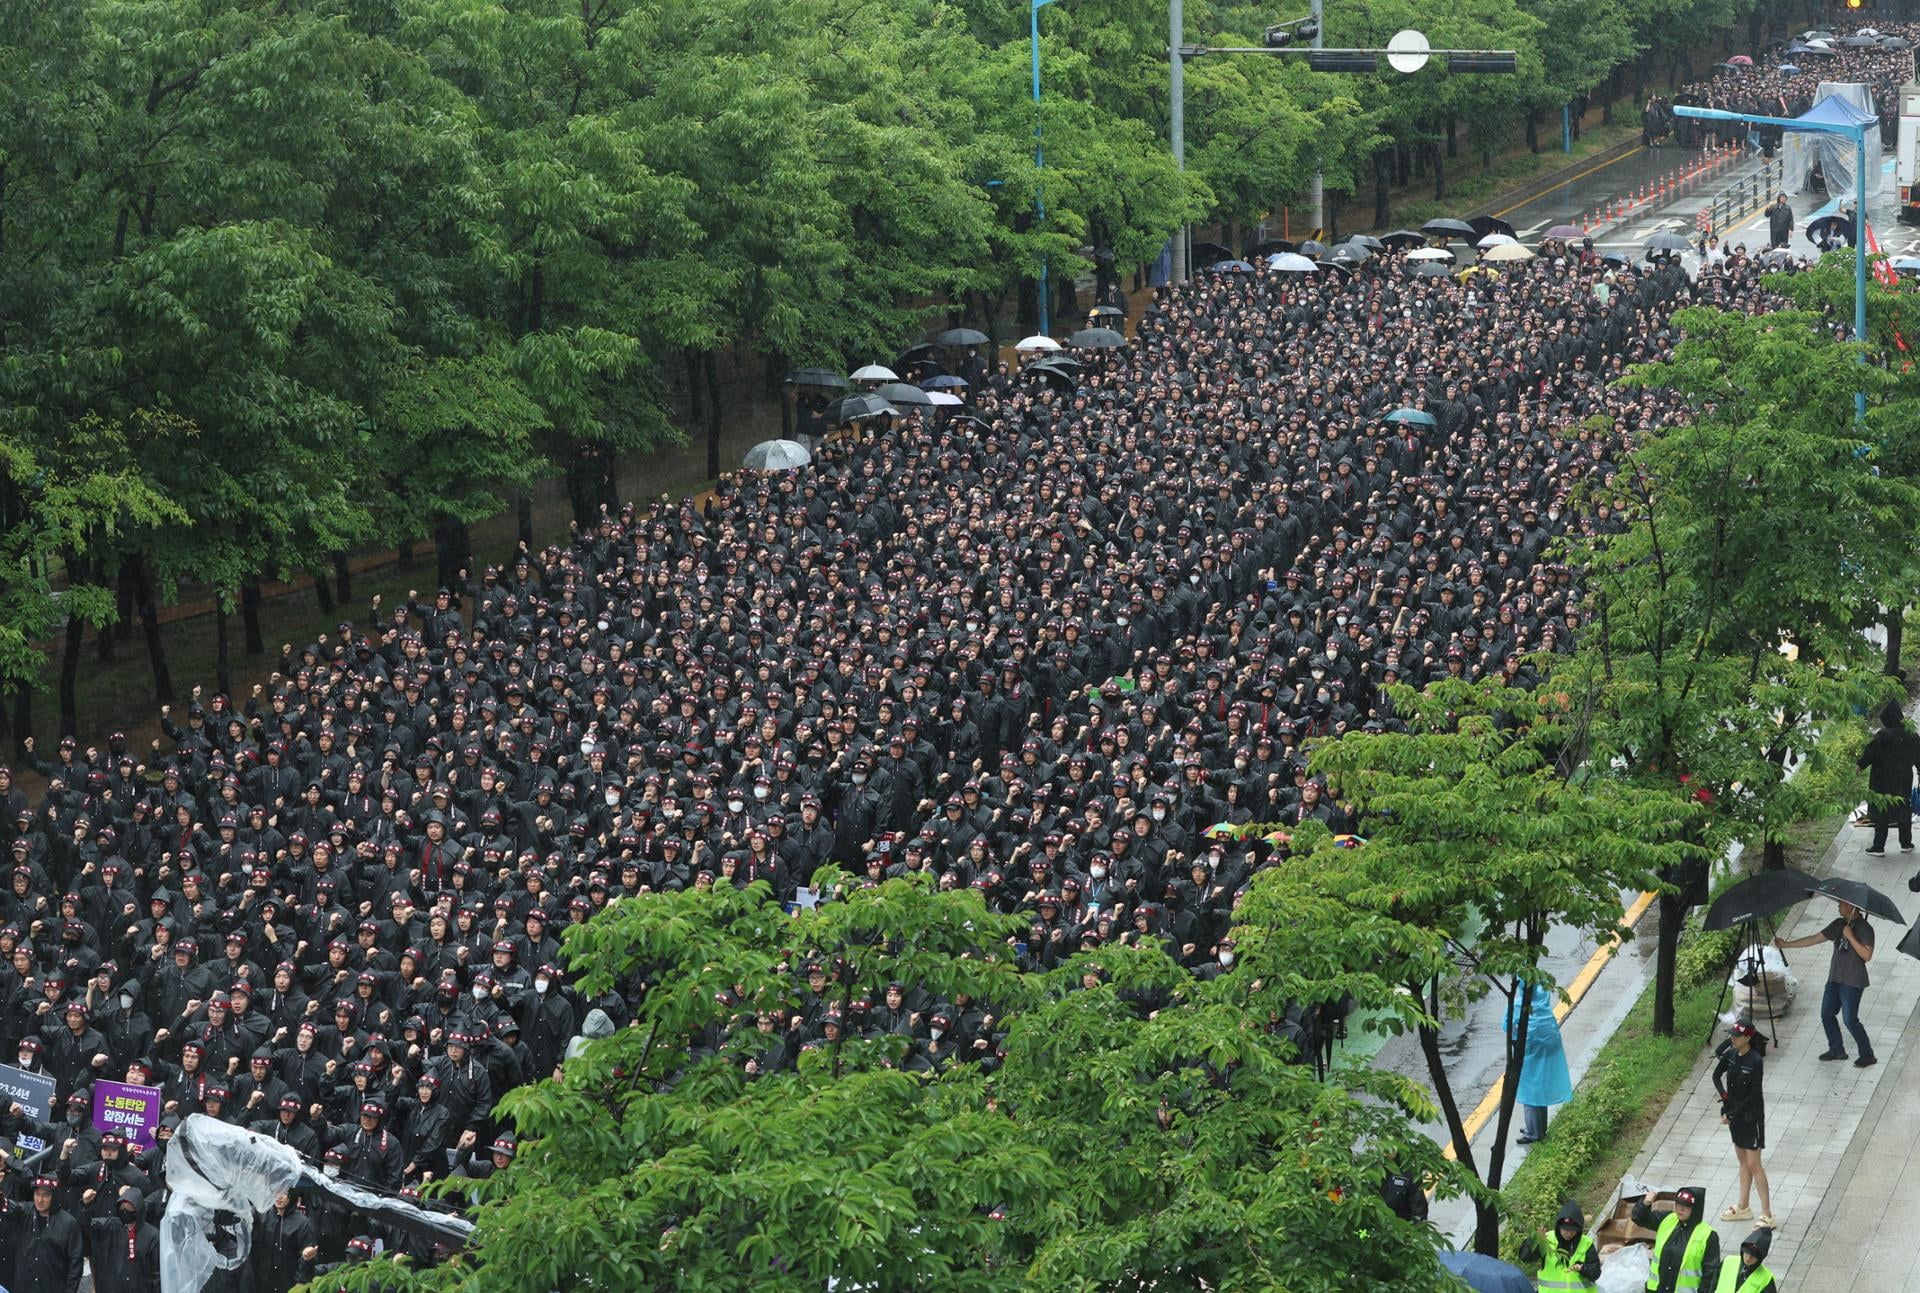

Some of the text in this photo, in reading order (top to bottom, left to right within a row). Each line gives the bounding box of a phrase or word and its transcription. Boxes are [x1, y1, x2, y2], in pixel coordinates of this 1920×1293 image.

[13, 1101, 40, 1118] 으로
[104, 1095, 146, 1112] 노동탄압
[103, 1109, 145, 1126] 앞장서는
